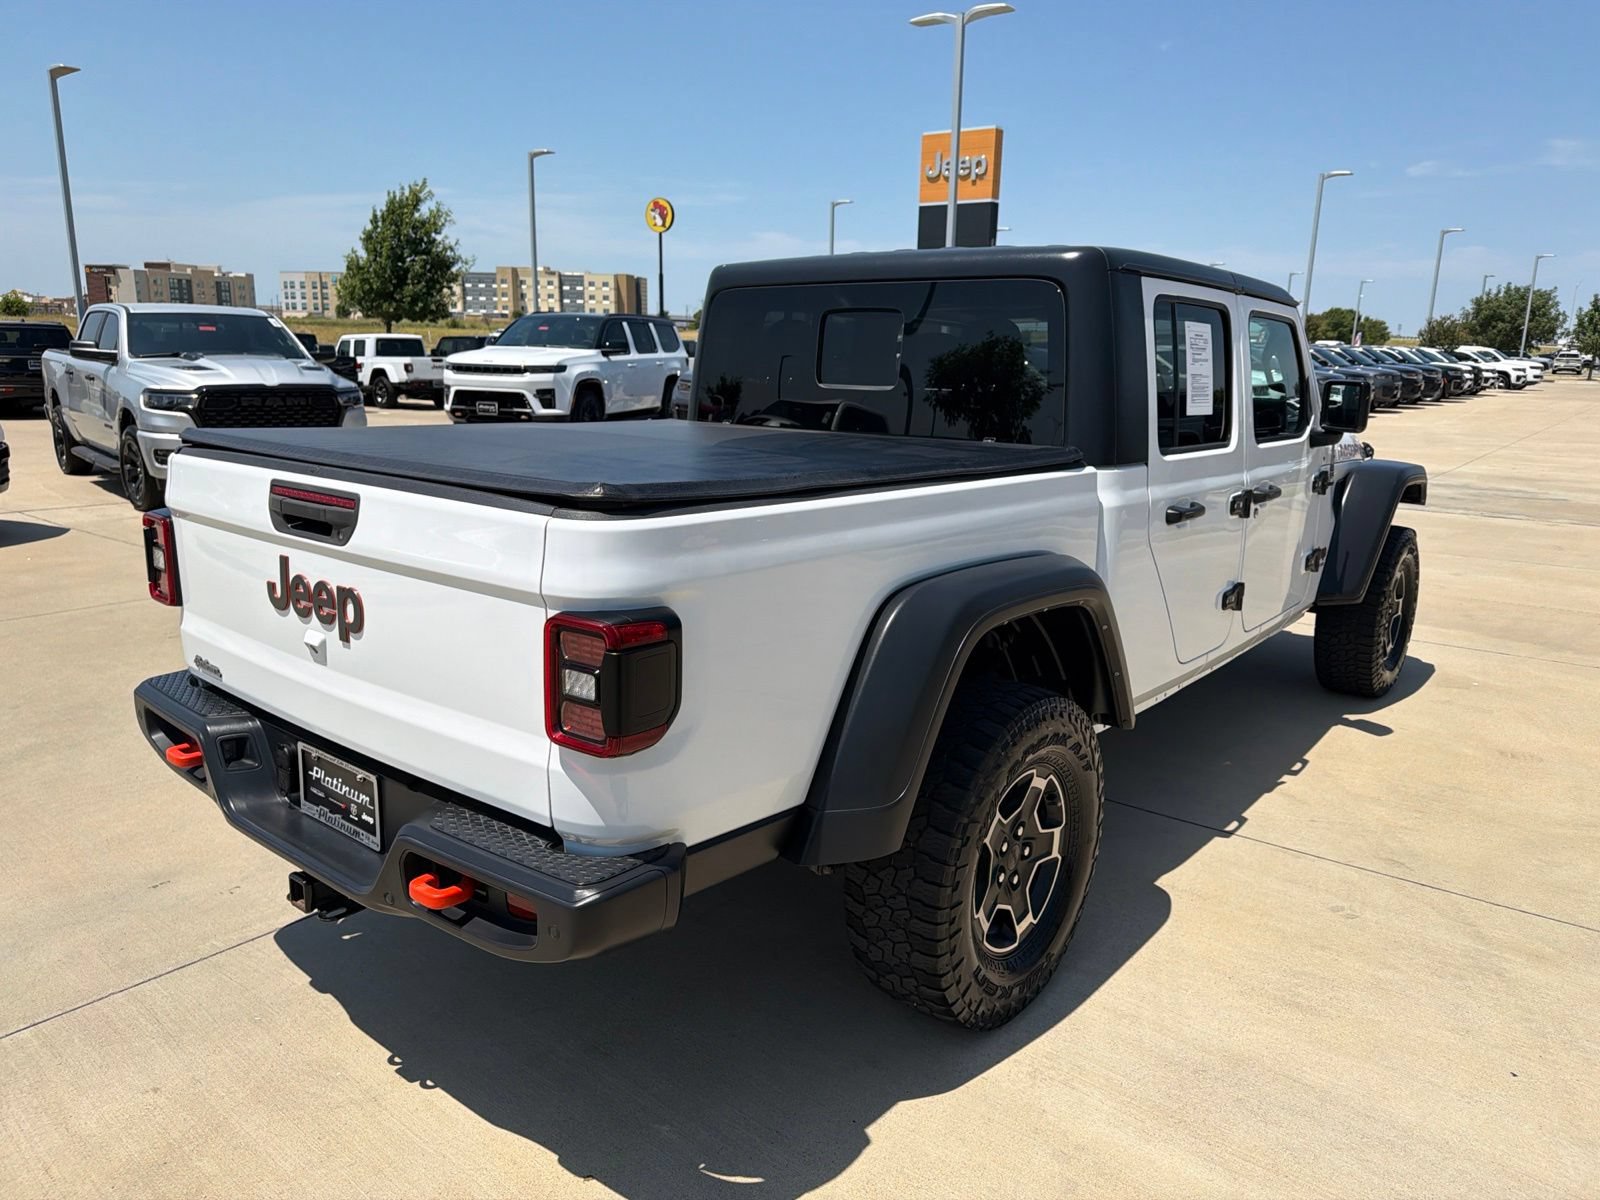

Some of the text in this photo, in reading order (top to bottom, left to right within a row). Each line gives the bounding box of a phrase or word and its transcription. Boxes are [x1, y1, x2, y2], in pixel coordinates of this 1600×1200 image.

[925, 150, 988, 182] Jeep
[240, 397, 306, 406] RAM
[266, 554, 365, 643] Jeep
[308, 766, 374, 810] Platinum
[318, 808, 364, 842] Platinum
